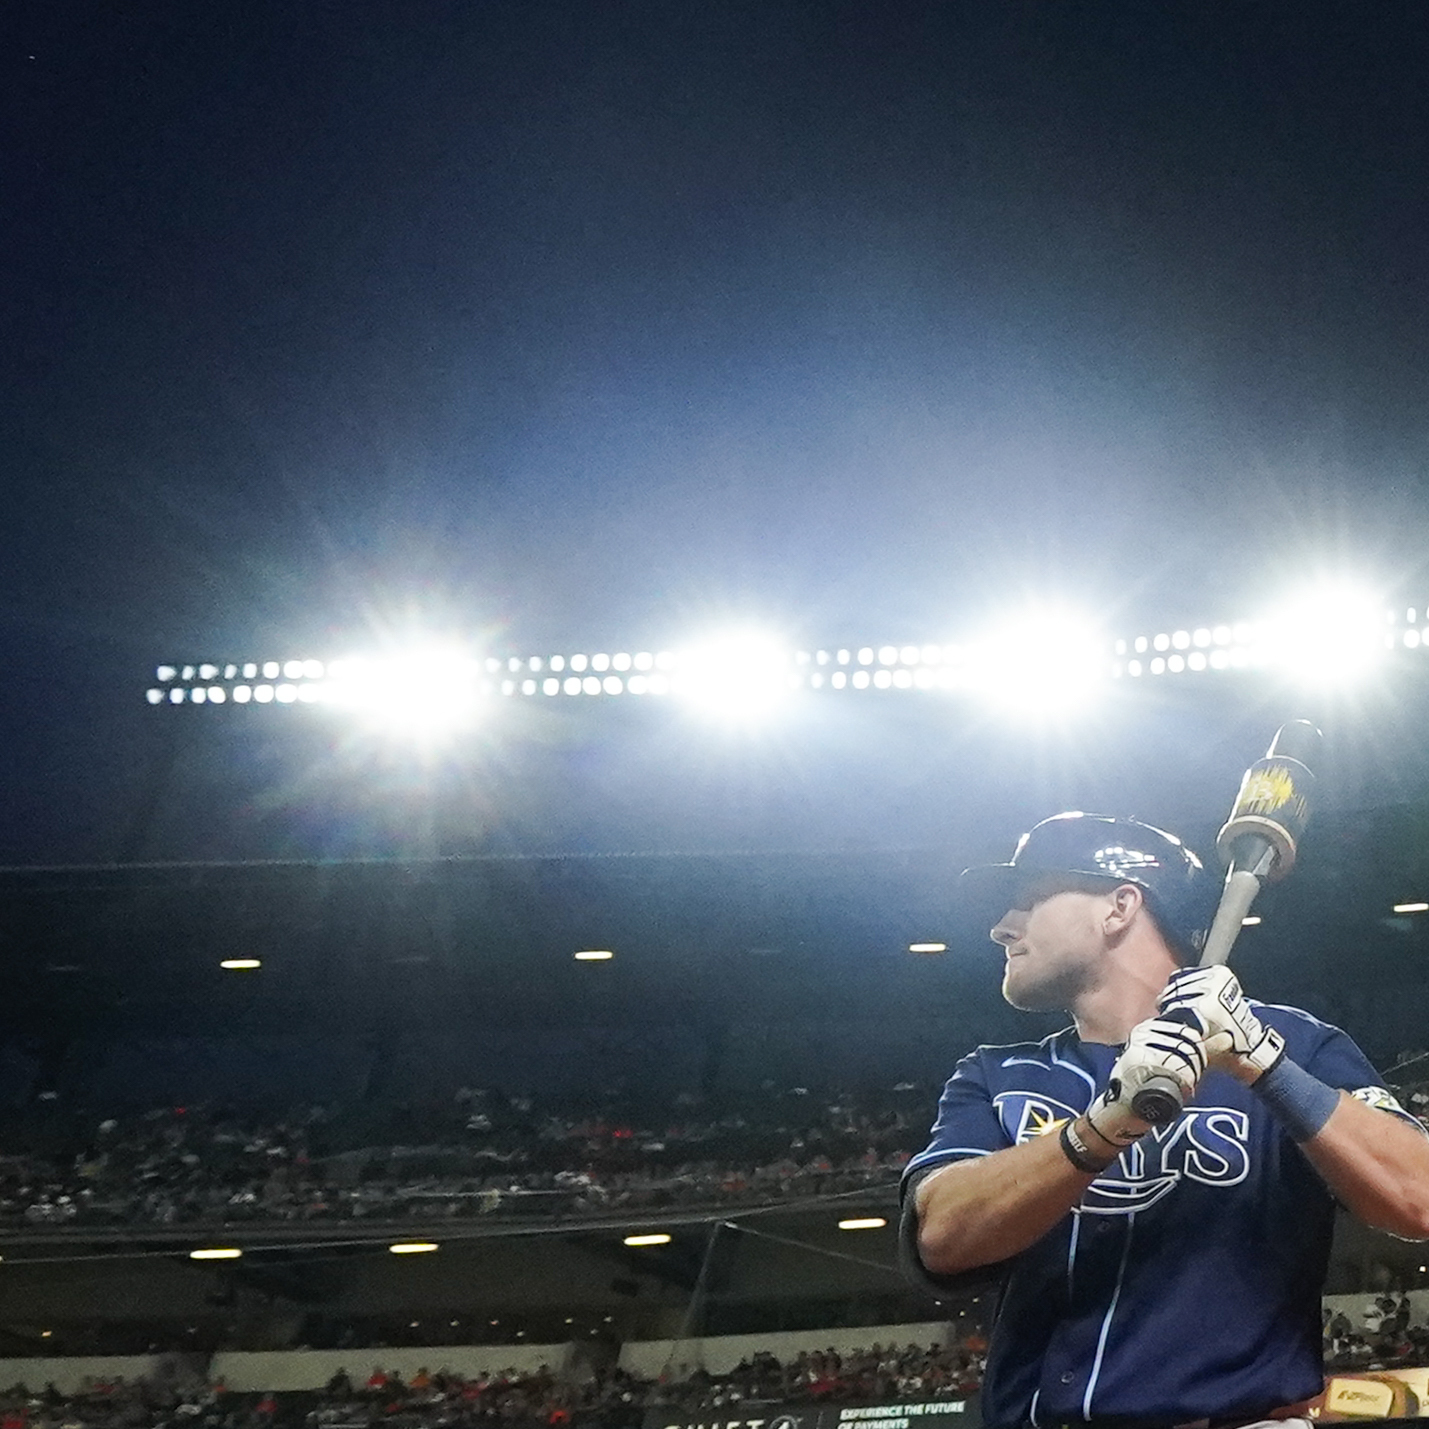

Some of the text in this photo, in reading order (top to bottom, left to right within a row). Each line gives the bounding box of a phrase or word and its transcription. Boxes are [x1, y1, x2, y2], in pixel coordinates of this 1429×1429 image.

[840, 1401, 966, 1420] EXPERIENCE THE FUTURE
